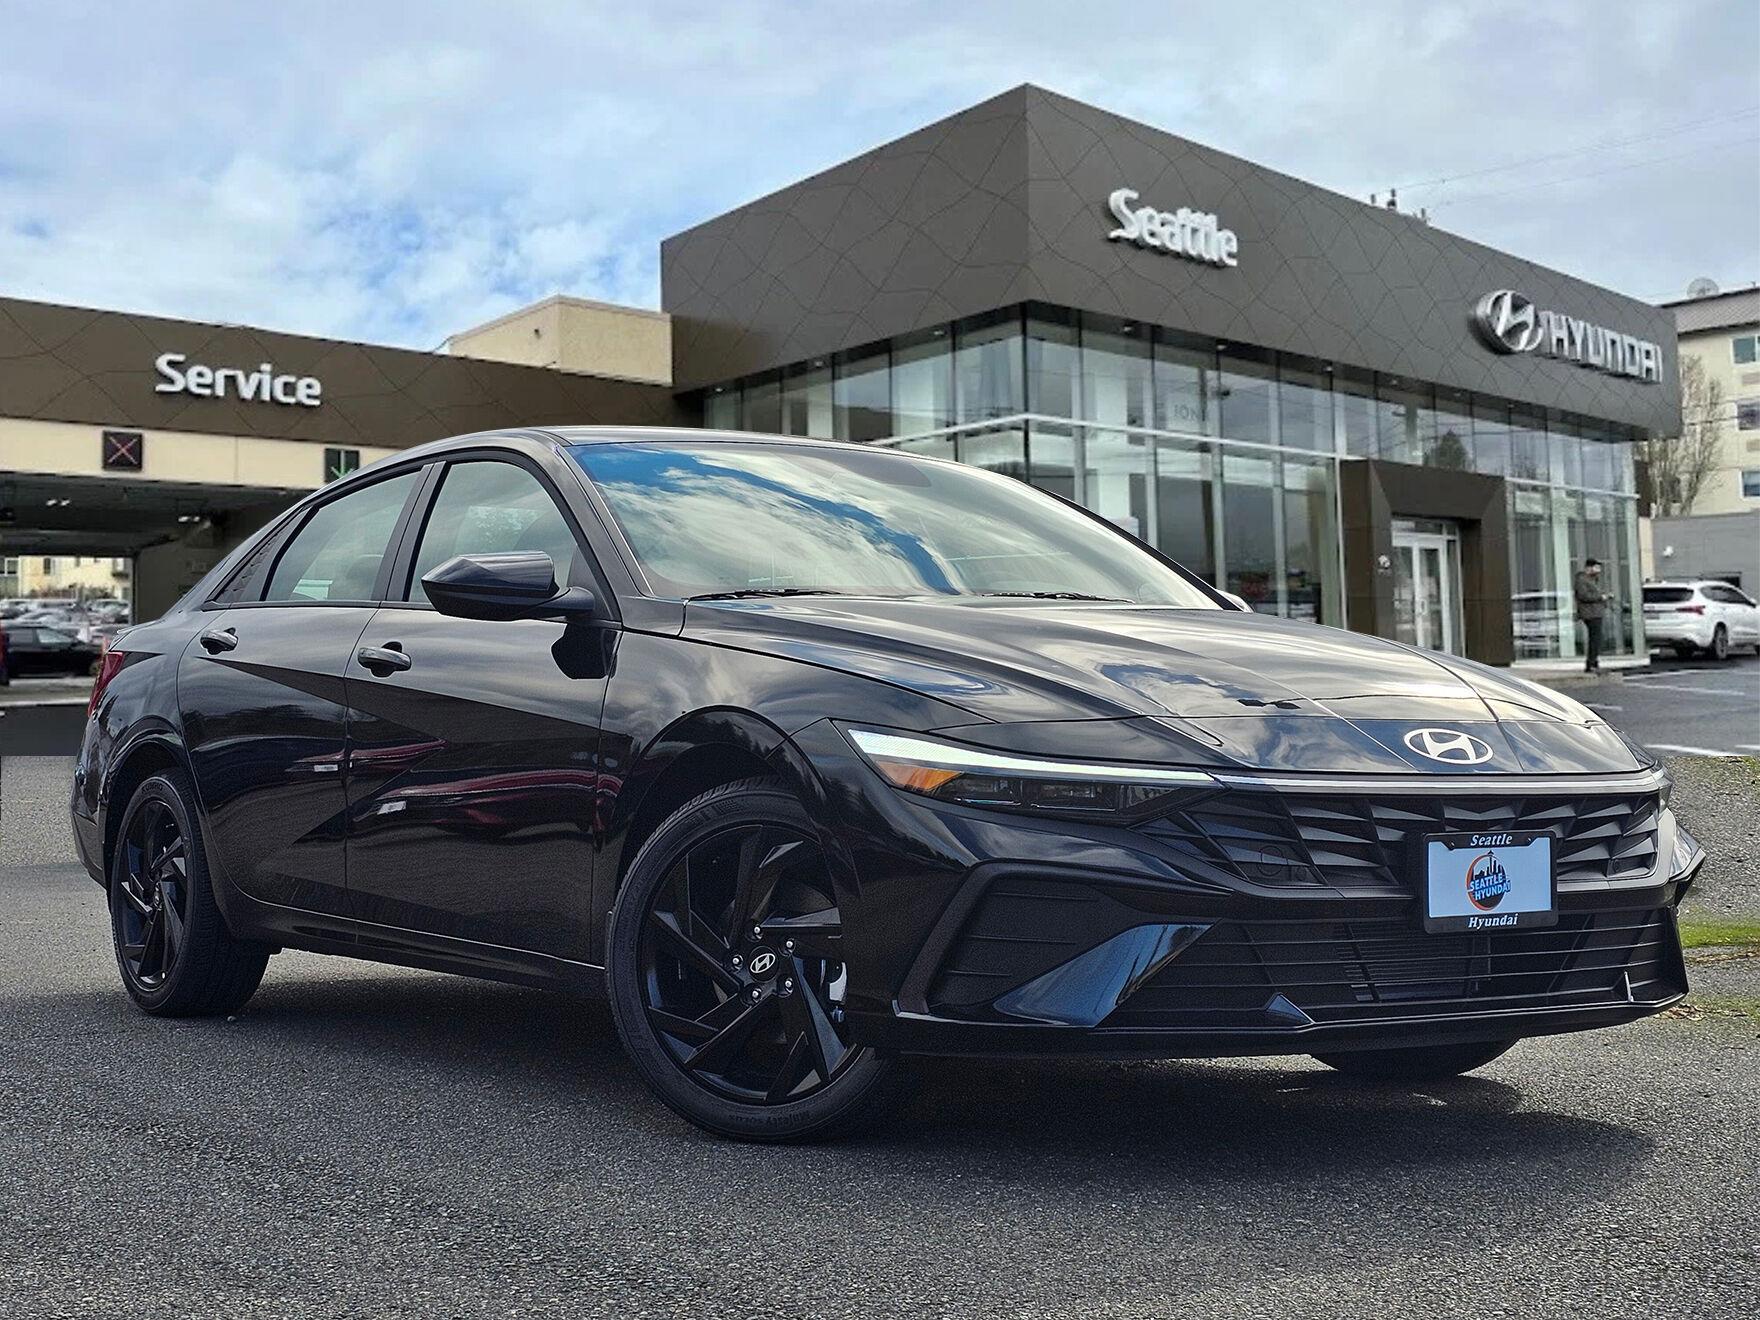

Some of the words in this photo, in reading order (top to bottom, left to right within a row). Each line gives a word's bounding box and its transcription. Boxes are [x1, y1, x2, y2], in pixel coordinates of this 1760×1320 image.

[1108, 187, 1239, 267] Seattle
[1541, 310, 1664, 384] HYUNDAI
[155, 352, 322, 407] Service
[1470, 833, 1513, 846] Seattle
[1469, 873, 1504, 892] SEATTLE
[1475, 880, 1512, 900] HYUNDAI
[1468, 913, 1518, 929] Hyundai
